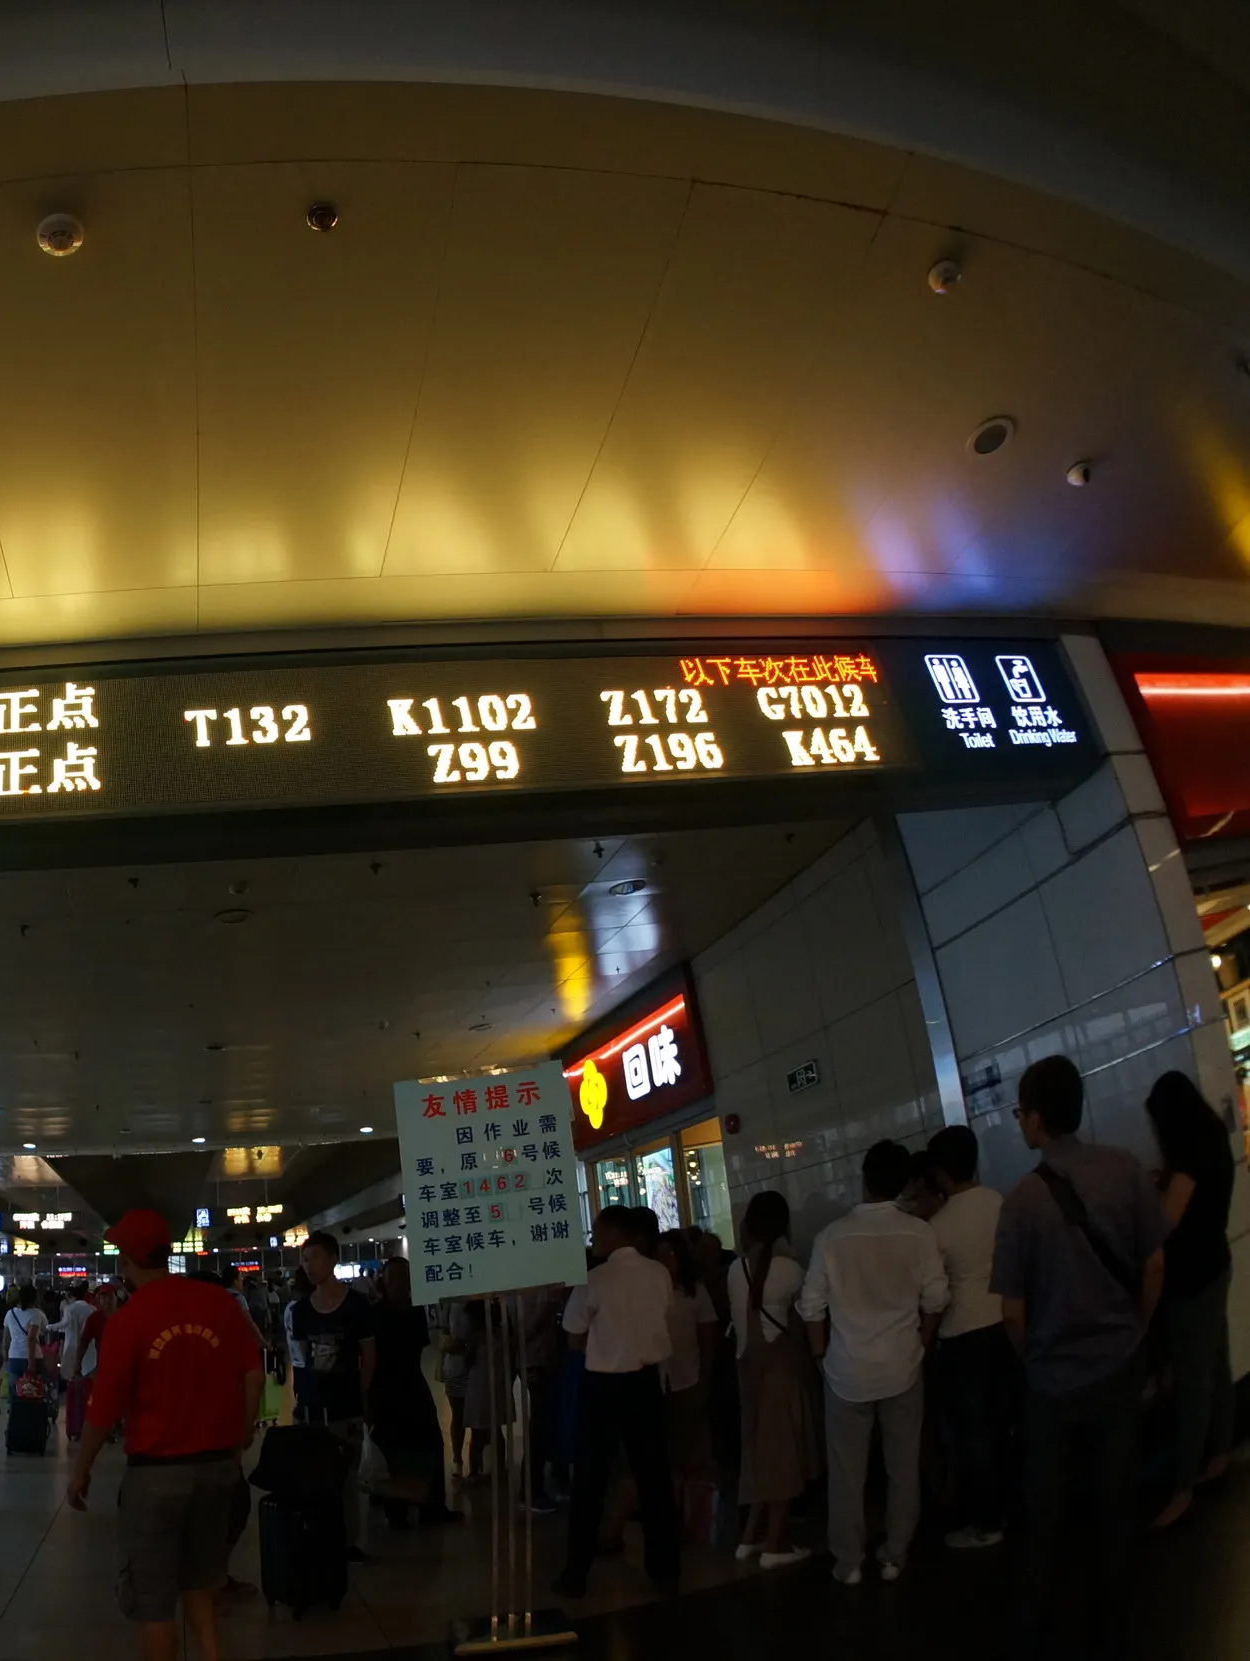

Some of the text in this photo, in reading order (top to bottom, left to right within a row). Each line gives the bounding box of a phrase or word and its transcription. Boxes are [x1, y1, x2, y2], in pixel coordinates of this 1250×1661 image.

[679, 654, 878, 686] 以下车次在此候车
[184, 684, 869, 747] T132 K1102 Z172 G7012
[941, 706, 997, 729] 洗手间
[1010, 705, 1063, 727] 饮用水
[959, 732, 996, 748] Toilet
[1008, 728, 1078, 747] Drinking Water
[427, 726, 880, 783] Z99 Z196 K464
[622, 1024, 682, 1101] 回味
[421, 1081, 542, 1119] 友情提示
[456, 1114, 558, 1145] 因作业需
